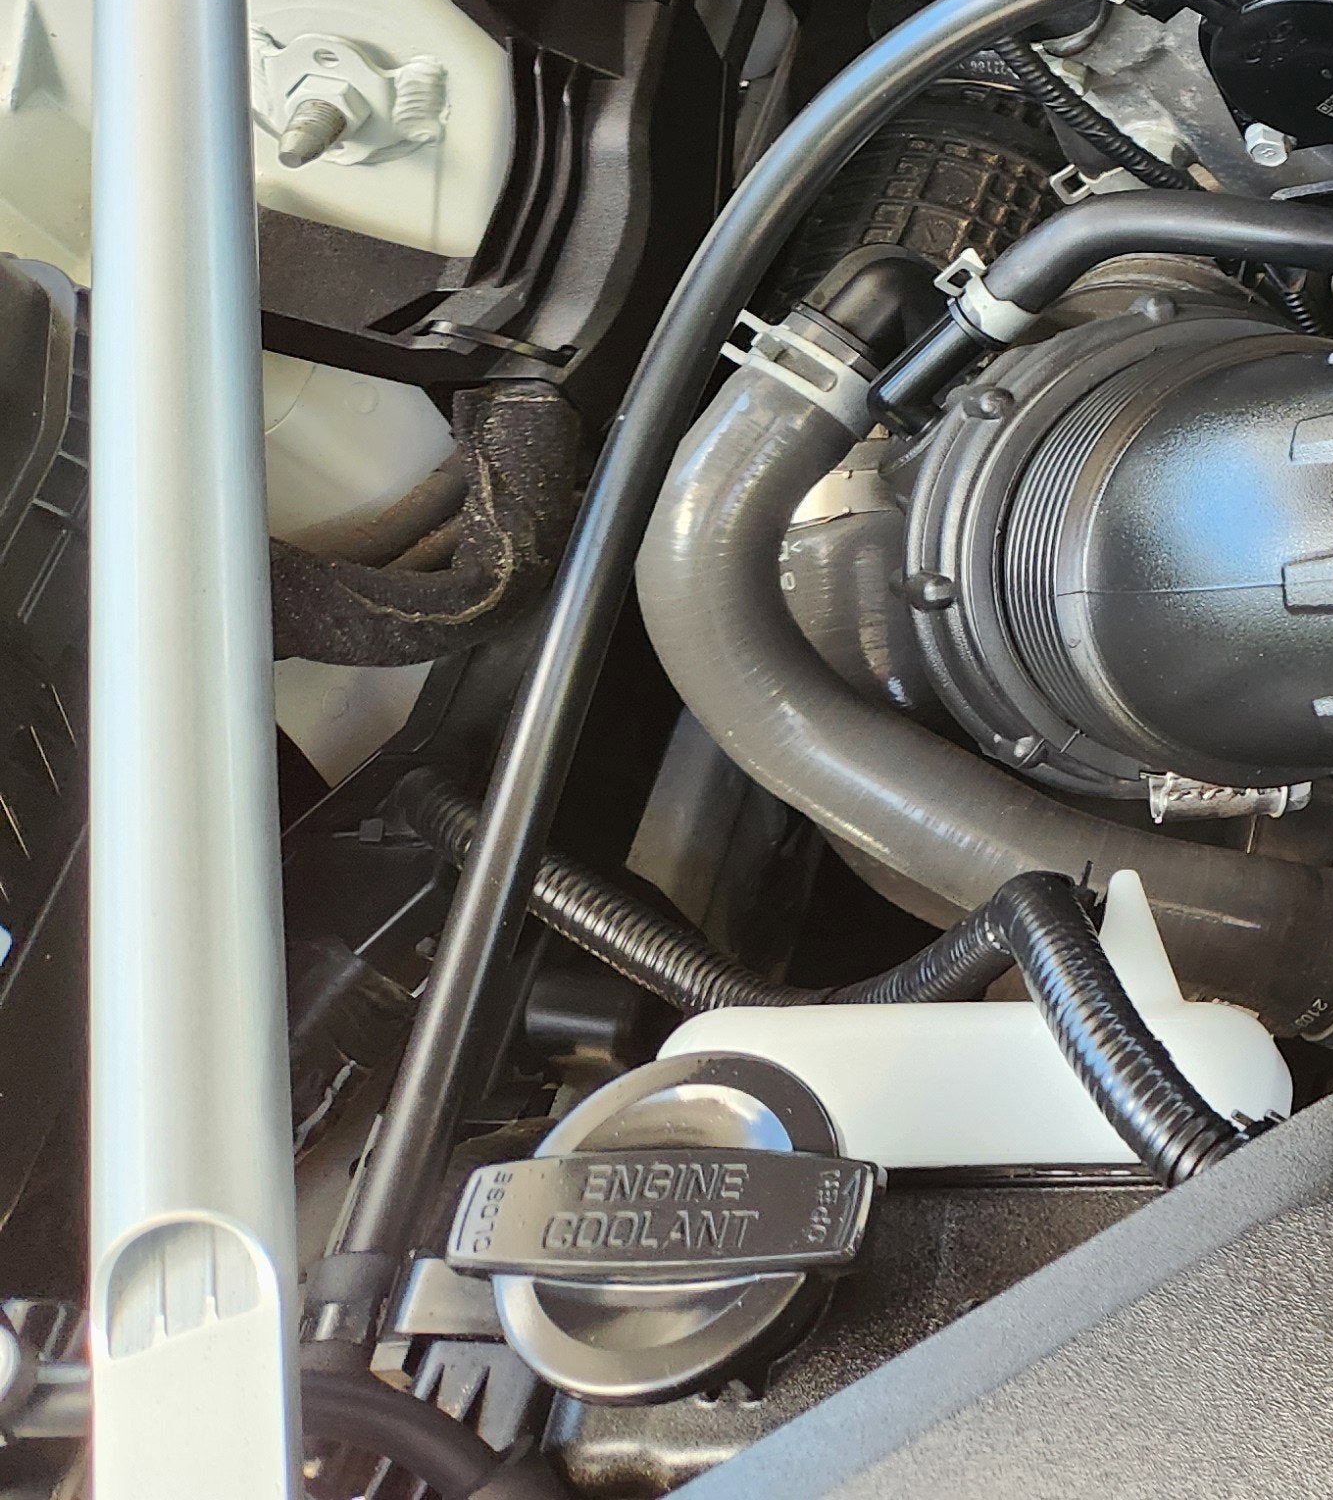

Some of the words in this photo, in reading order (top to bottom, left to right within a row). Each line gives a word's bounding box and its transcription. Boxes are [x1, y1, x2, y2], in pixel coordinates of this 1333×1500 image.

[580, 1161, 750, 1203] ENGINE
[804, 1168, 842, 1245] OPEN
[472, 1171, 514, 1254] CLOSE
[540, 1208, 760, 1251] COOLANT
